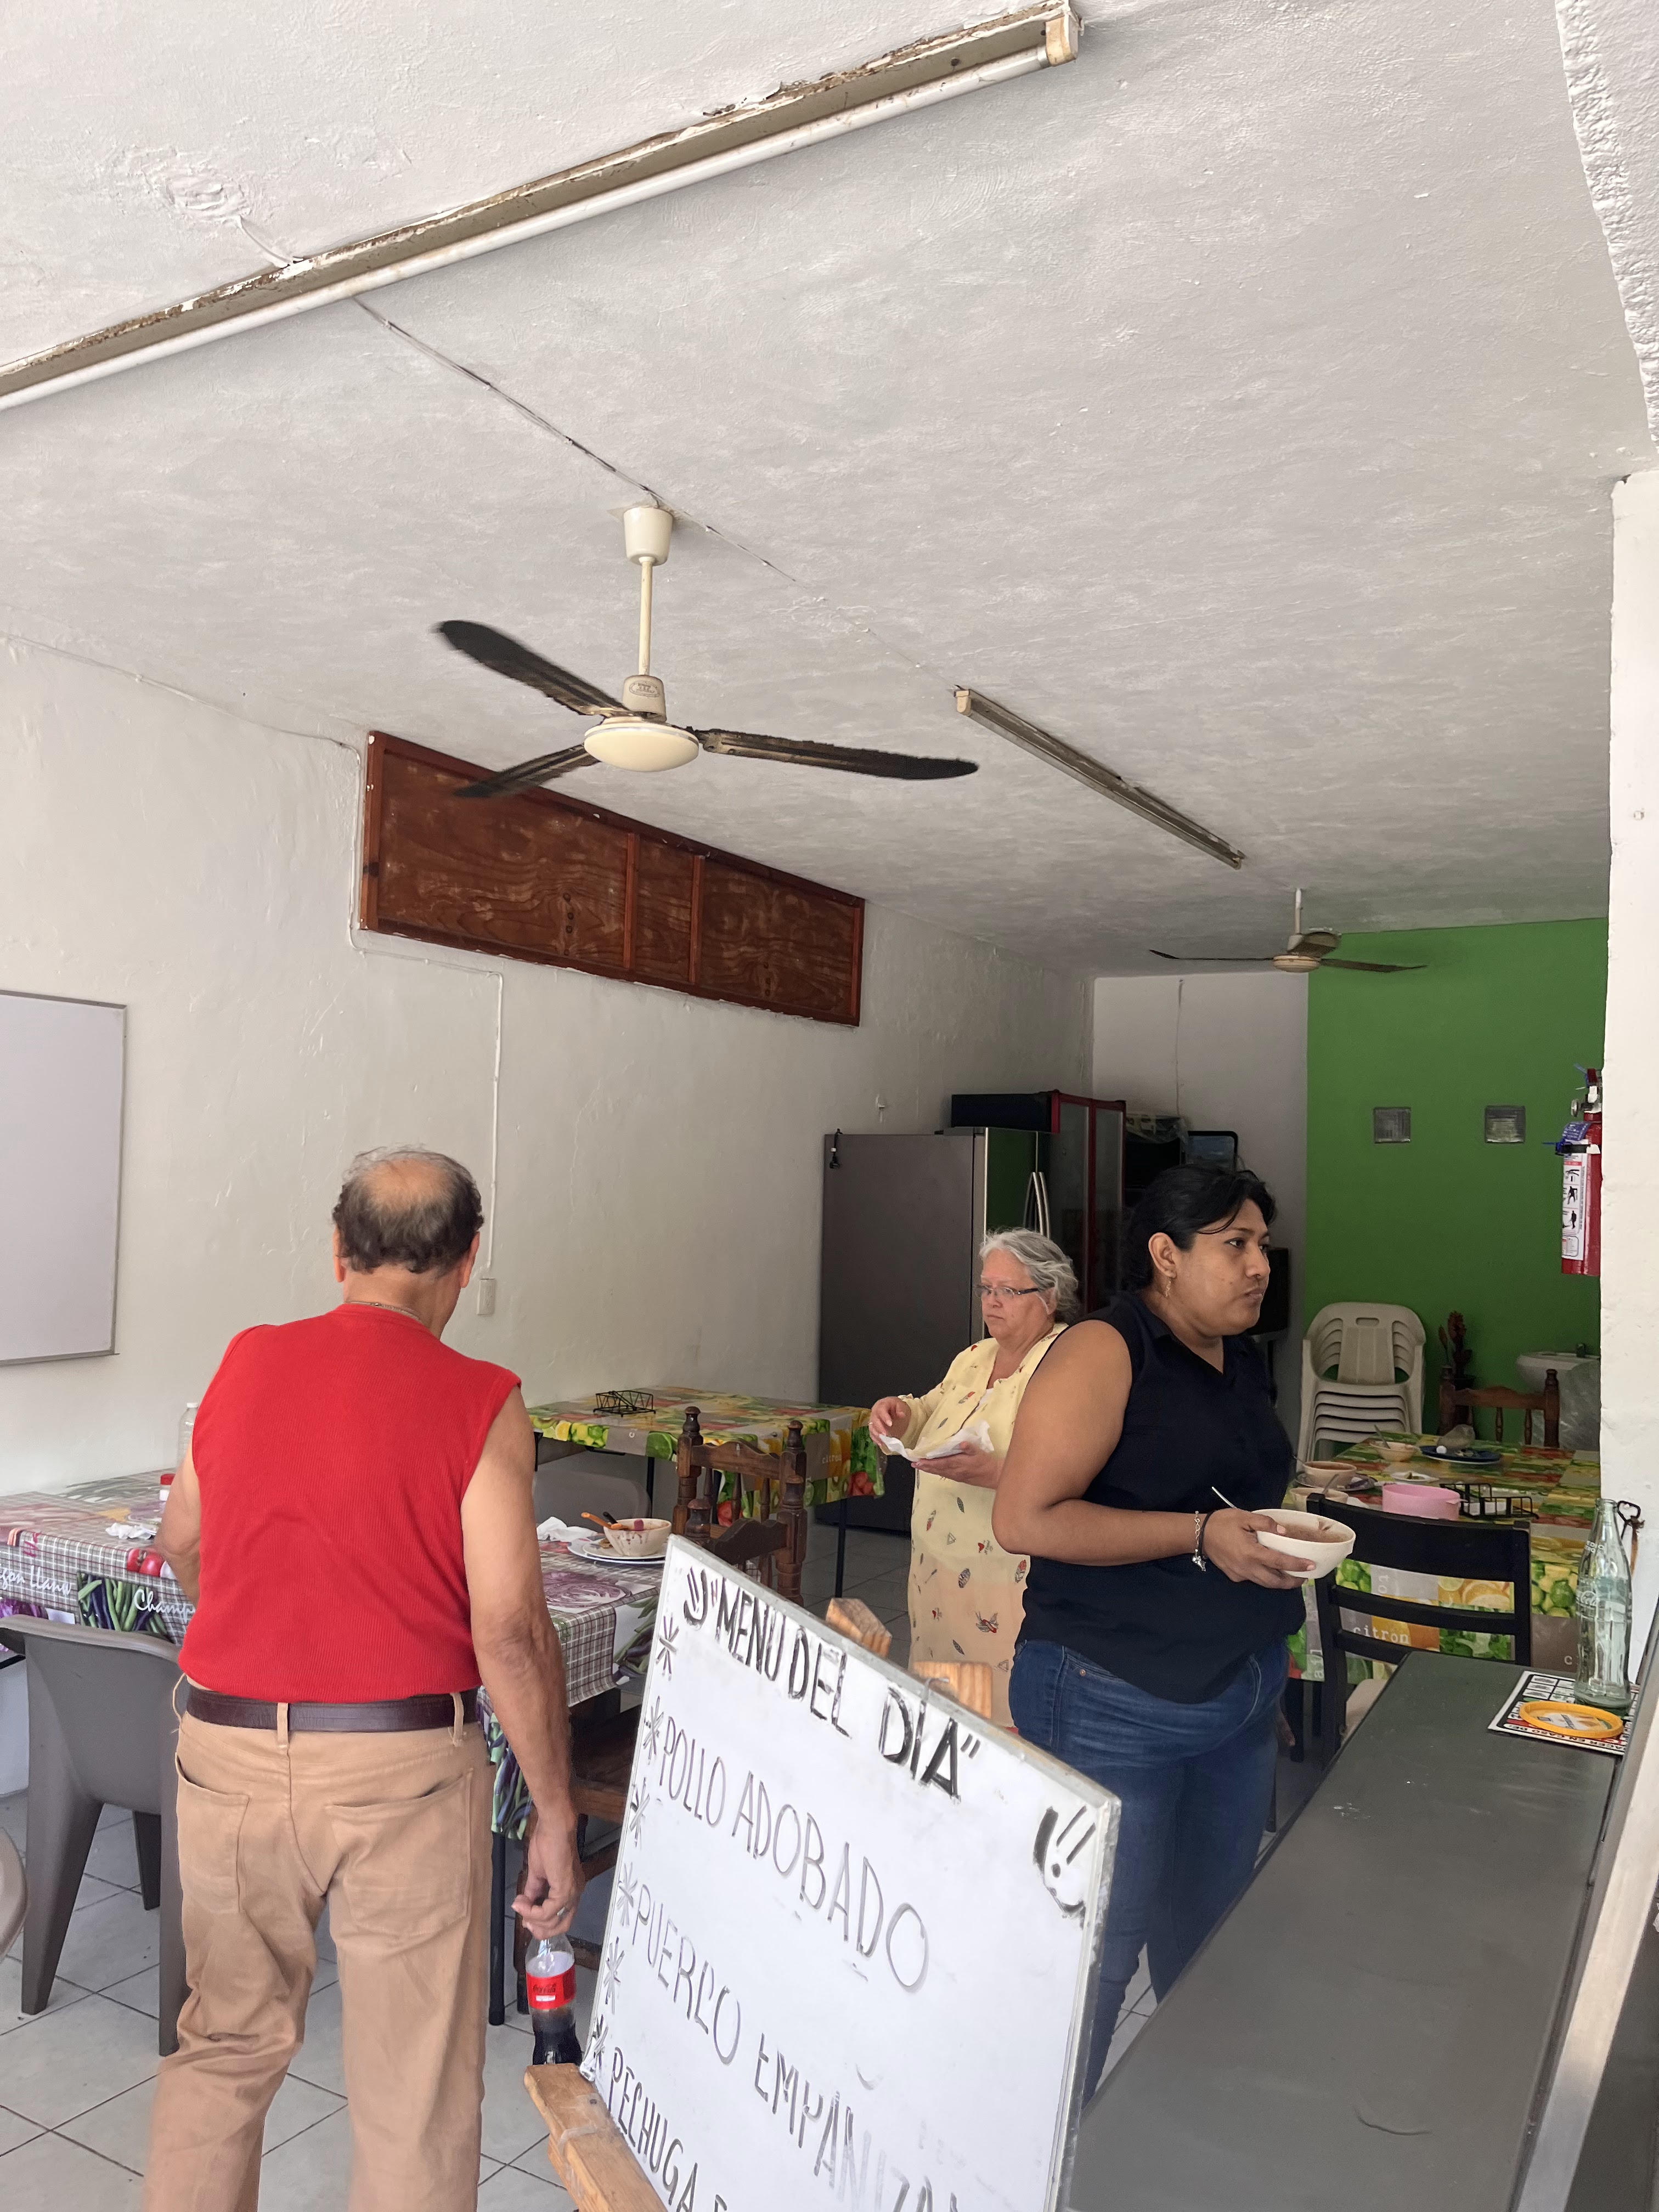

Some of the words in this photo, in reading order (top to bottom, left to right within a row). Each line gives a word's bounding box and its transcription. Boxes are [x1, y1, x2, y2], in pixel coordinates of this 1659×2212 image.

[788, 1626, 852, 1739] DEL
[1352, 1625, 1409, 1645] citron
[659, 1716, 726, 1827] POLLO
[732, 1770, 929, 1992] ADOBADO
[632, 1884, 741, 2066] PUERCO
[608, 2046, 698, 2212] PECHUGA
